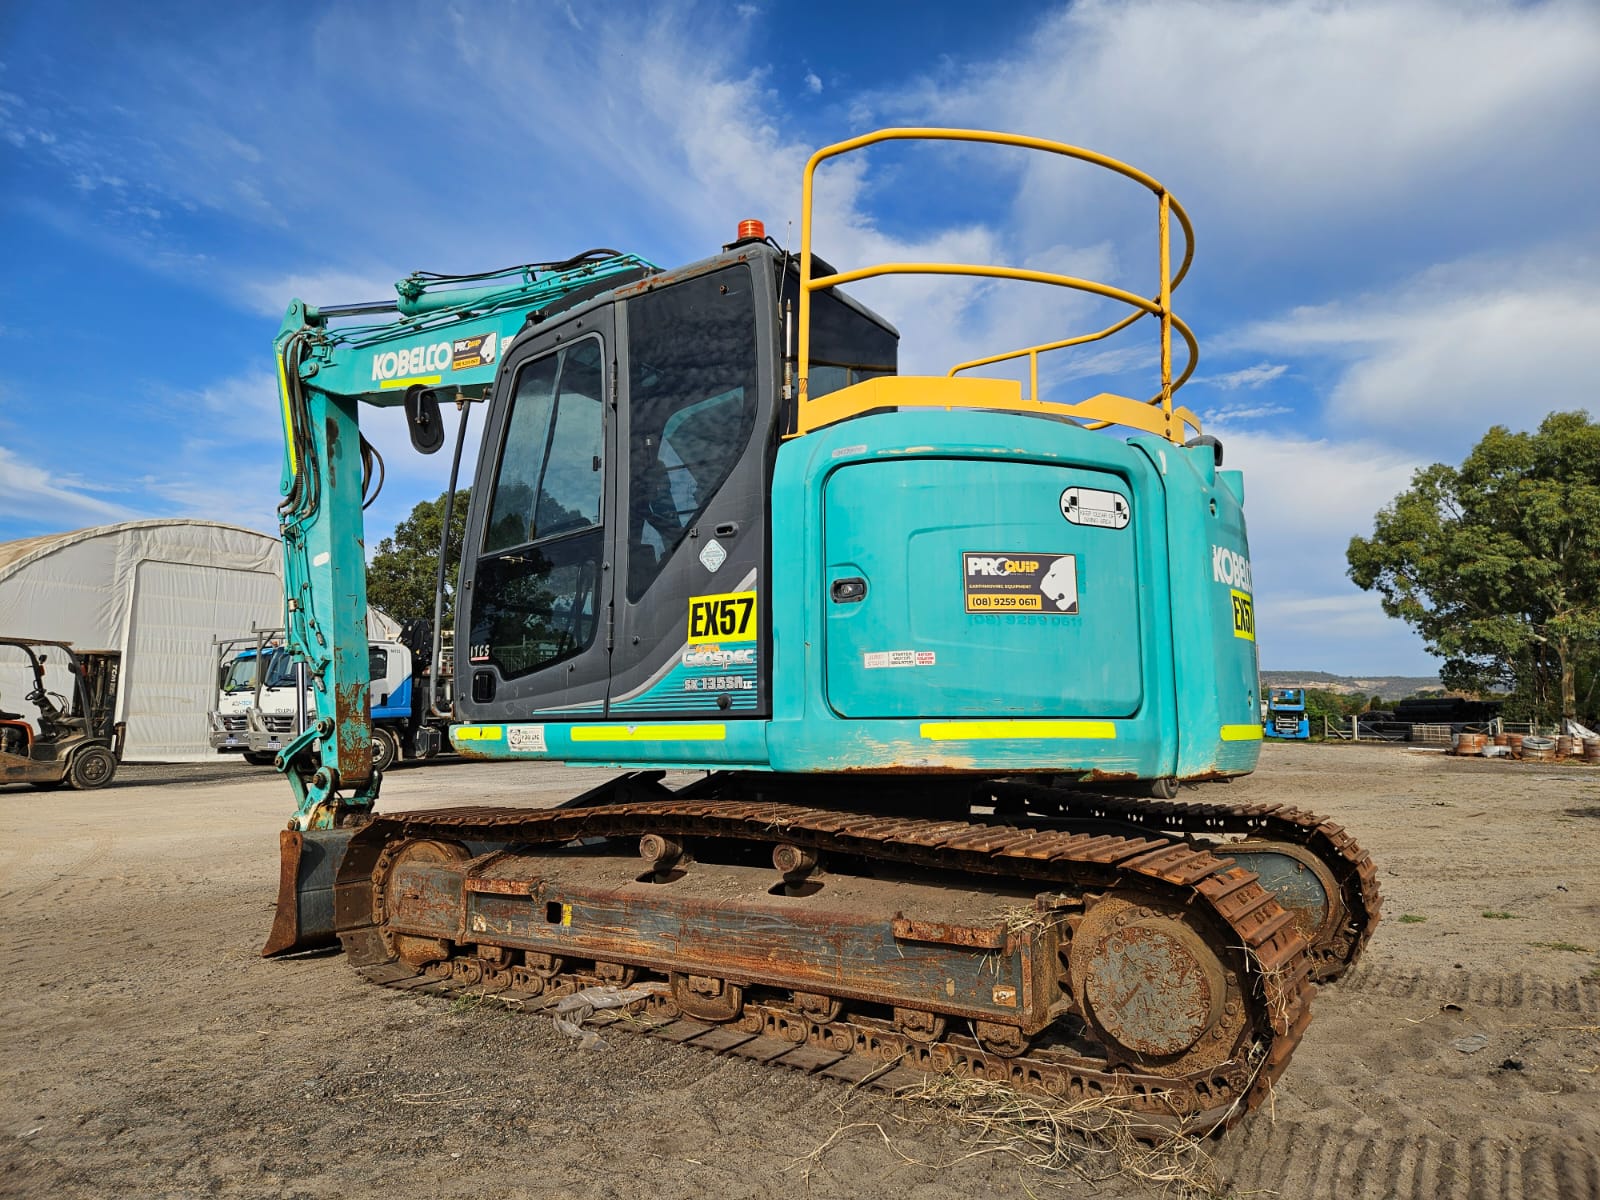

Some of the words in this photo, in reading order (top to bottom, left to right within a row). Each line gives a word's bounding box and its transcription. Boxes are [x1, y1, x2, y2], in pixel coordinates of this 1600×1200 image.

[372, 342, 453, 380] KOBELCO
[690, 597, 754, 638] EX57
[972, 597, 991, 607] (08)
[993, 598, 1016, 606] 9259
[1018, 598, 1037, 606] 0611
